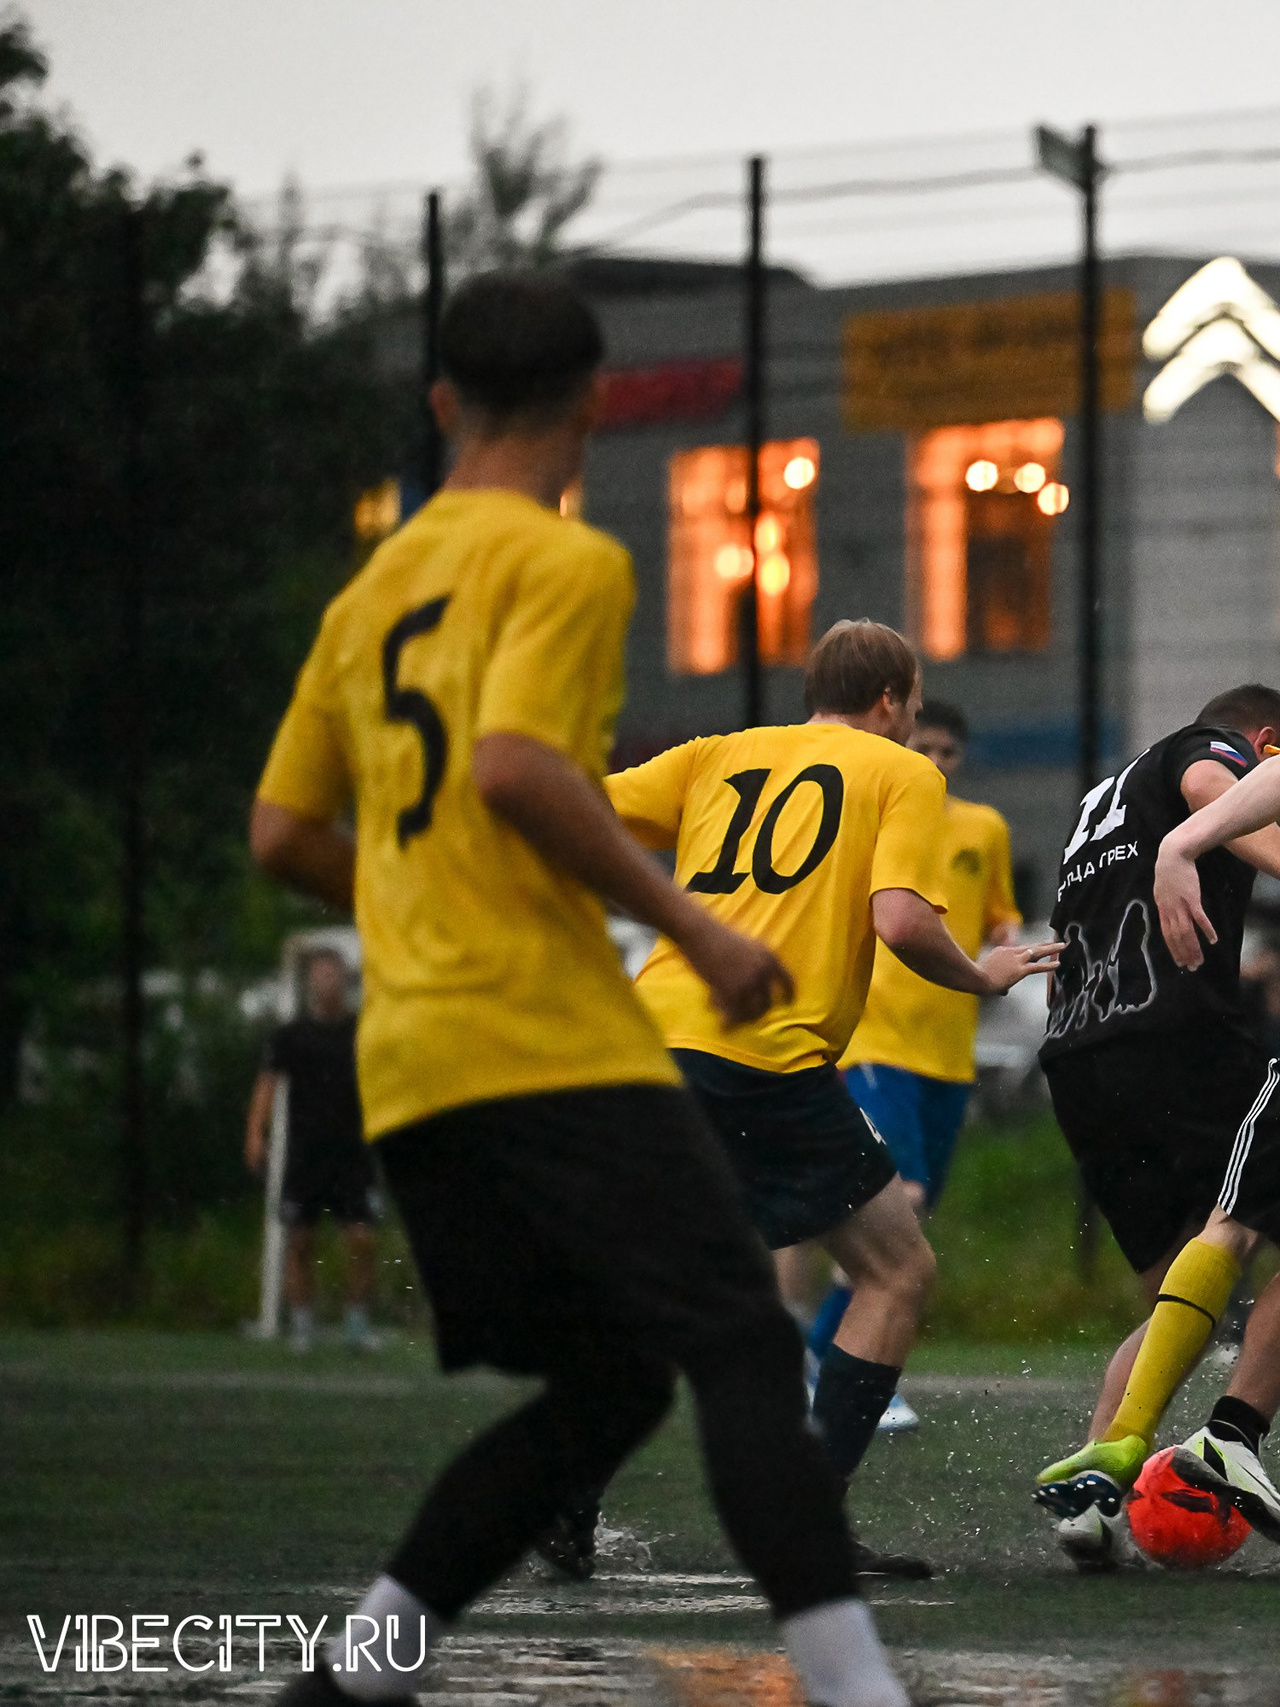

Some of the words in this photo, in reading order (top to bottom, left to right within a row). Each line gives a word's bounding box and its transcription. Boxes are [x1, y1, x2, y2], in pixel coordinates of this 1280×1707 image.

[382, 591, 453, 849] 5
[685, 763, 844, 895] 10
[1099, 841, 1139, 868] ГРЕХ
